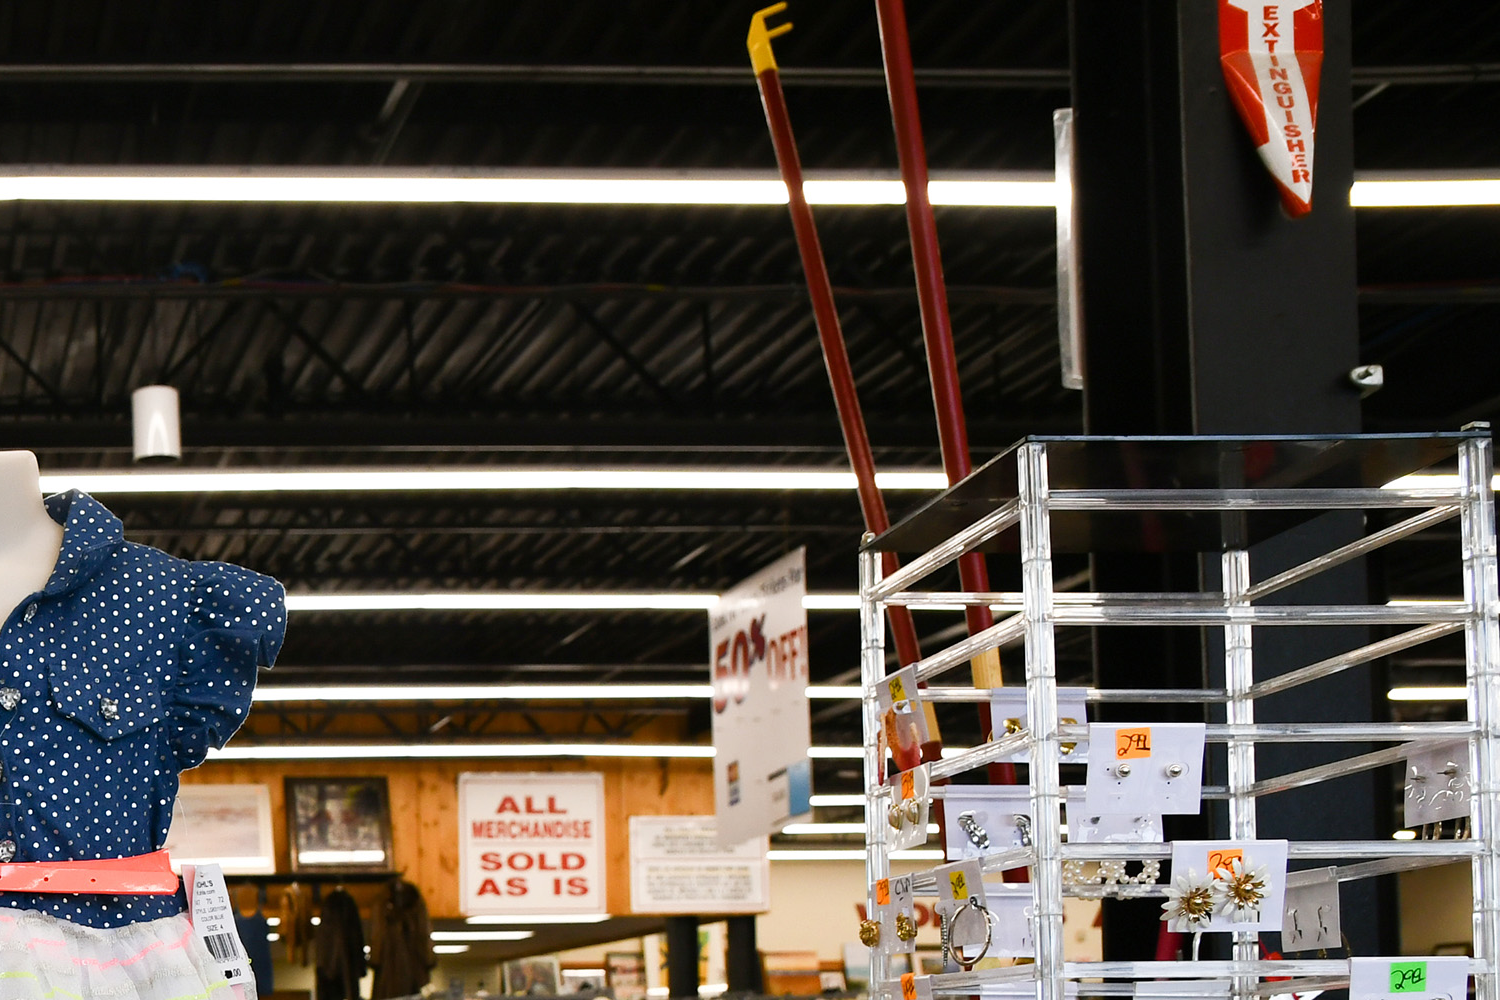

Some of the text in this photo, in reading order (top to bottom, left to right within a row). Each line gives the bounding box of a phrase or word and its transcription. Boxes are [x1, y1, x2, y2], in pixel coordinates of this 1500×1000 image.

[1262, 5, 1311, 184] EXTINGUISHER
[1117, 733, 1151, 756] 299
[497, 796, 567, 814] ALL
[472, 820, 592, 839] MERCHANDISE
[481, 853, 586, 871] SOLD
[477, 877, 588, 896] AS IS
[1390, 967, 1425, 990] 299
